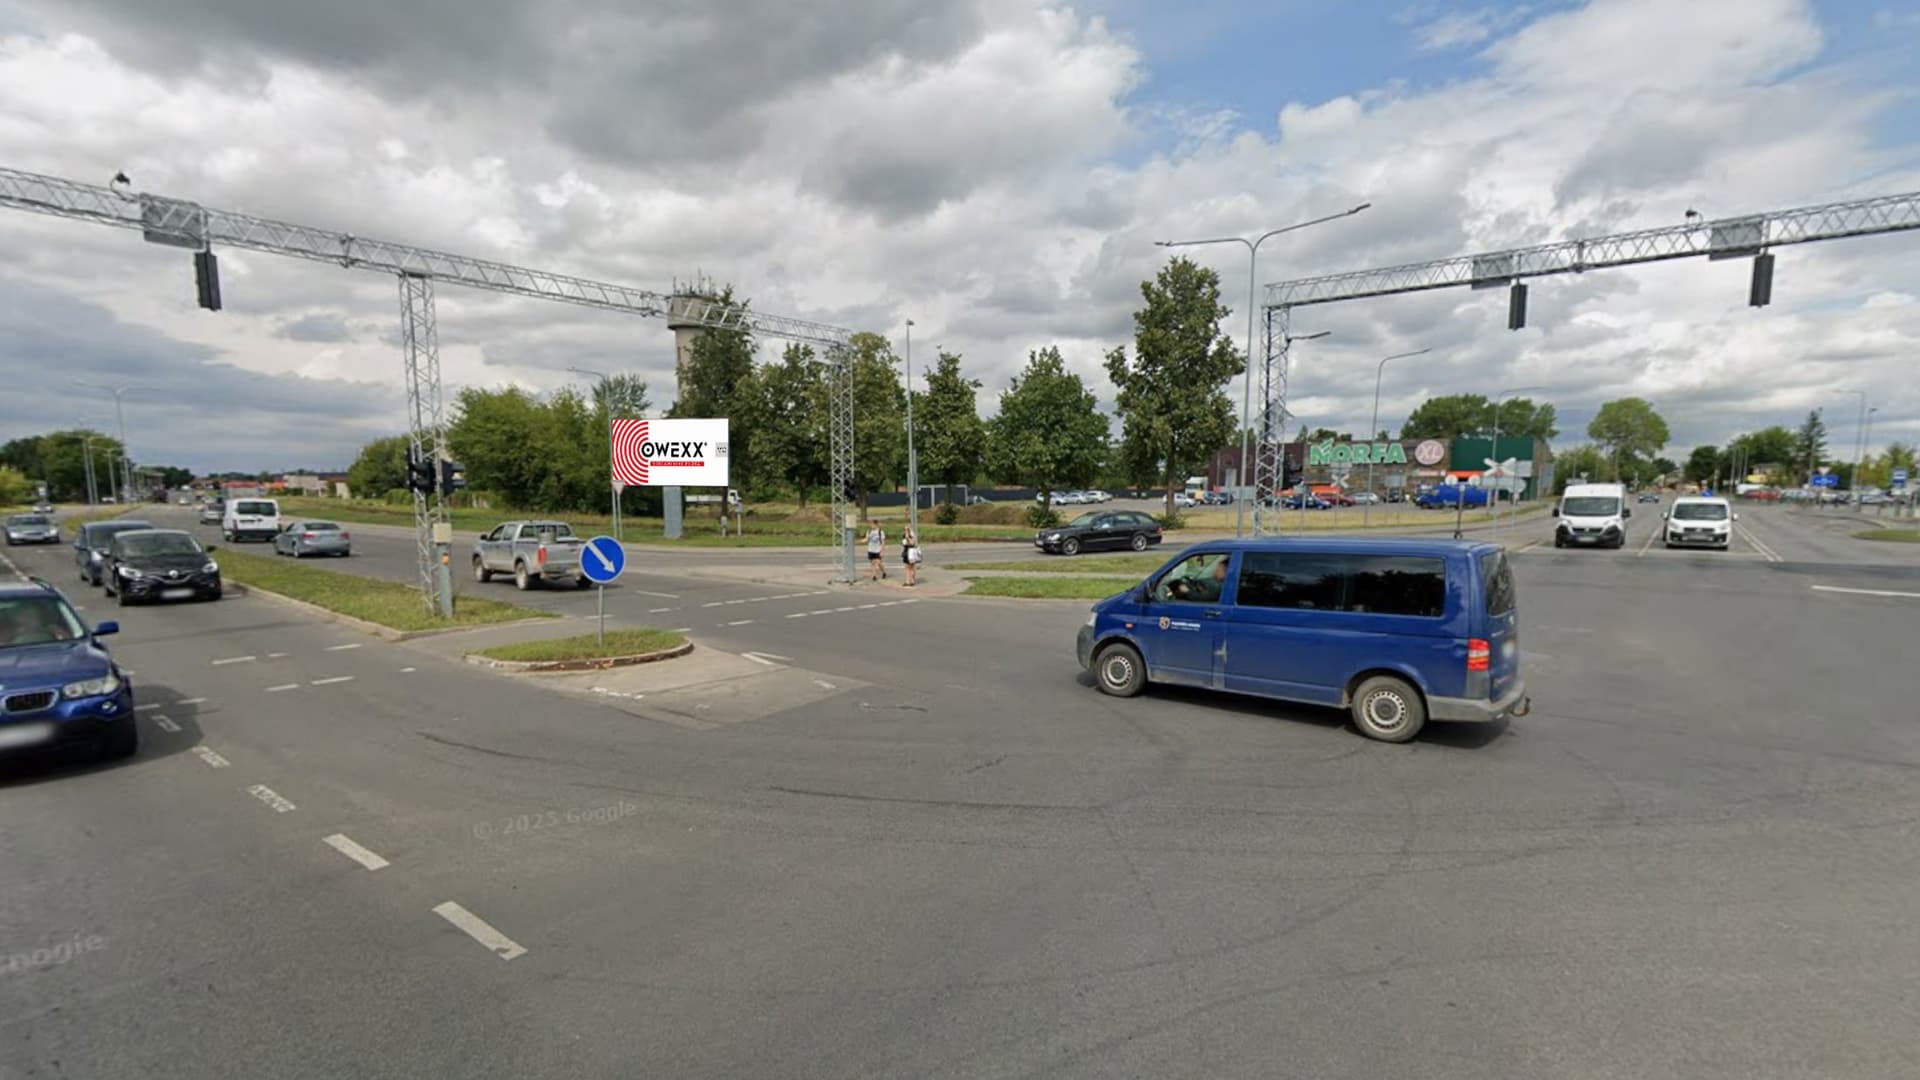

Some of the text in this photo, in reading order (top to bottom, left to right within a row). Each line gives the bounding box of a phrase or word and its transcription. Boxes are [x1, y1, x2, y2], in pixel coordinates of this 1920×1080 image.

[641, 442, 704, 458] OWEXX
[1310, 438, 1407, 465] NORFA
[1420, 443, 1441, 458] XL
